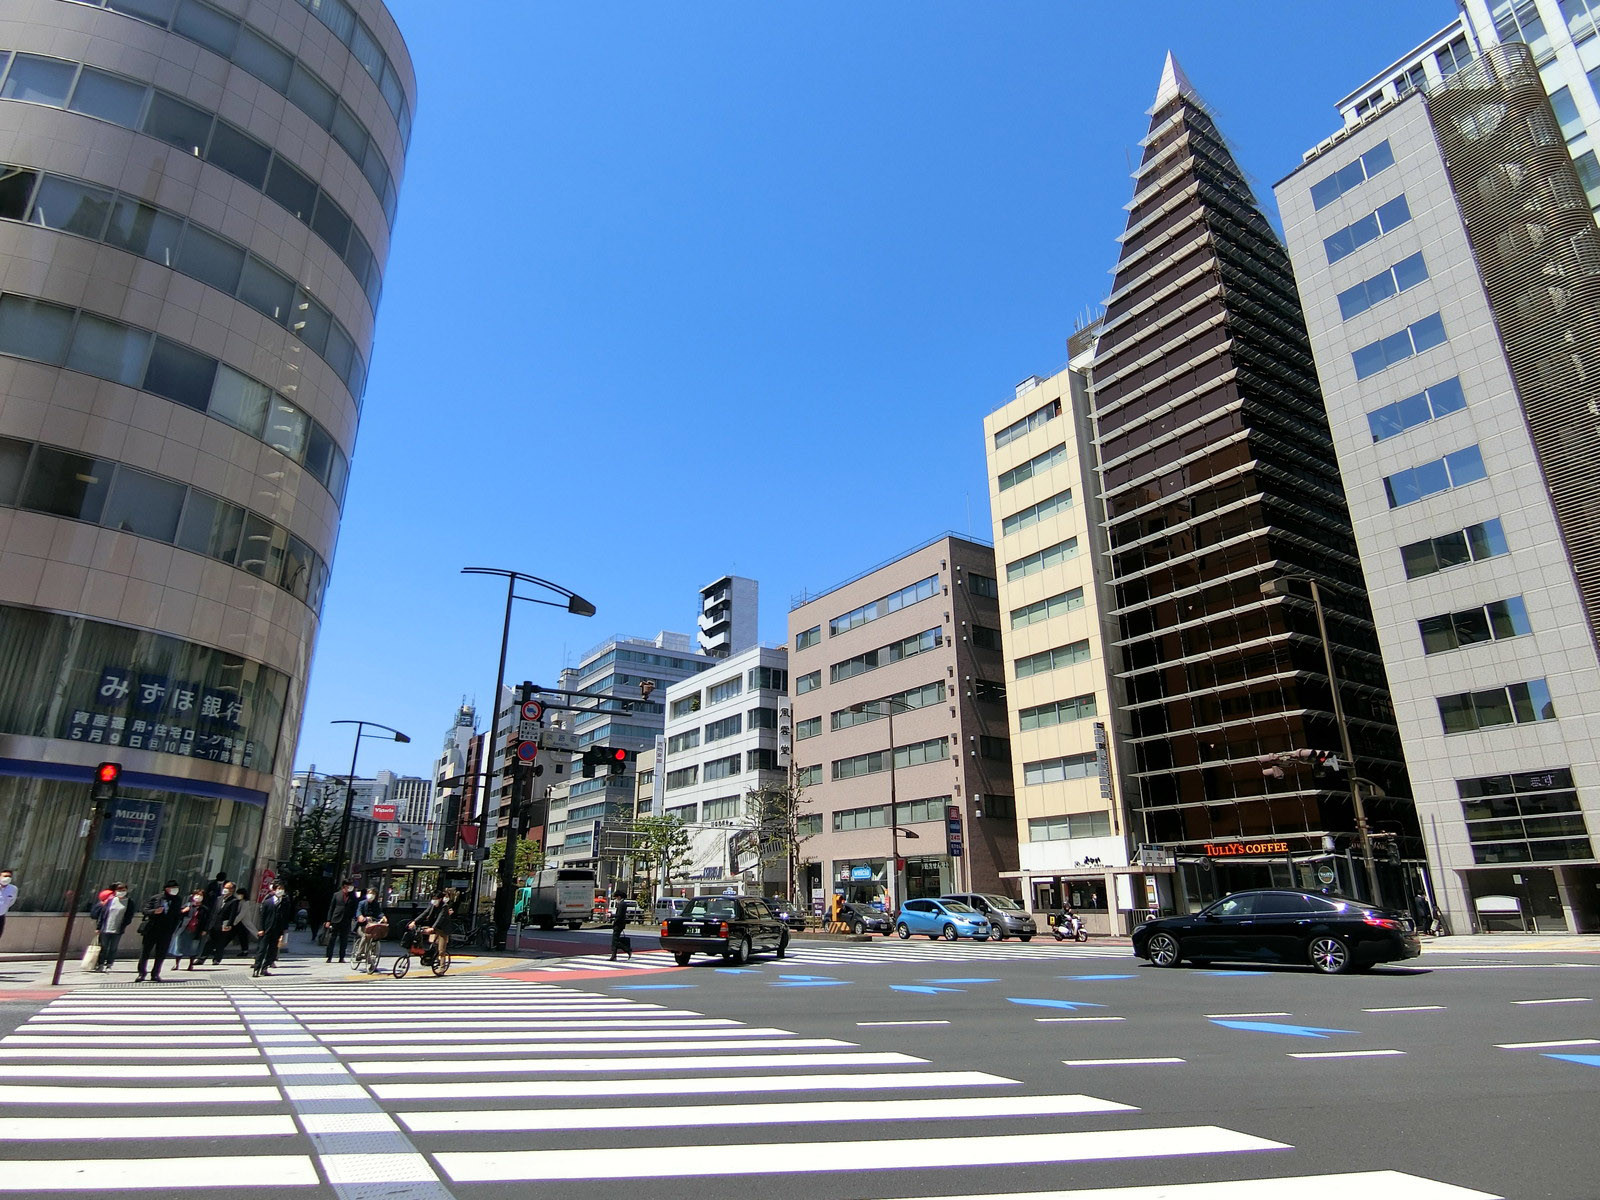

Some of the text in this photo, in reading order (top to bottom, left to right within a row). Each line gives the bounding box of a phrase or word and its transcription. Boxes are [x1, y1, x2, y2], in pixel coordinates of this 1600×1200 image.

[101, 676, 243, 725] みずほ銀行
[115, 809, 156, 820] MIZUHO
[1246, 842, 1289, 854] COFFEE
